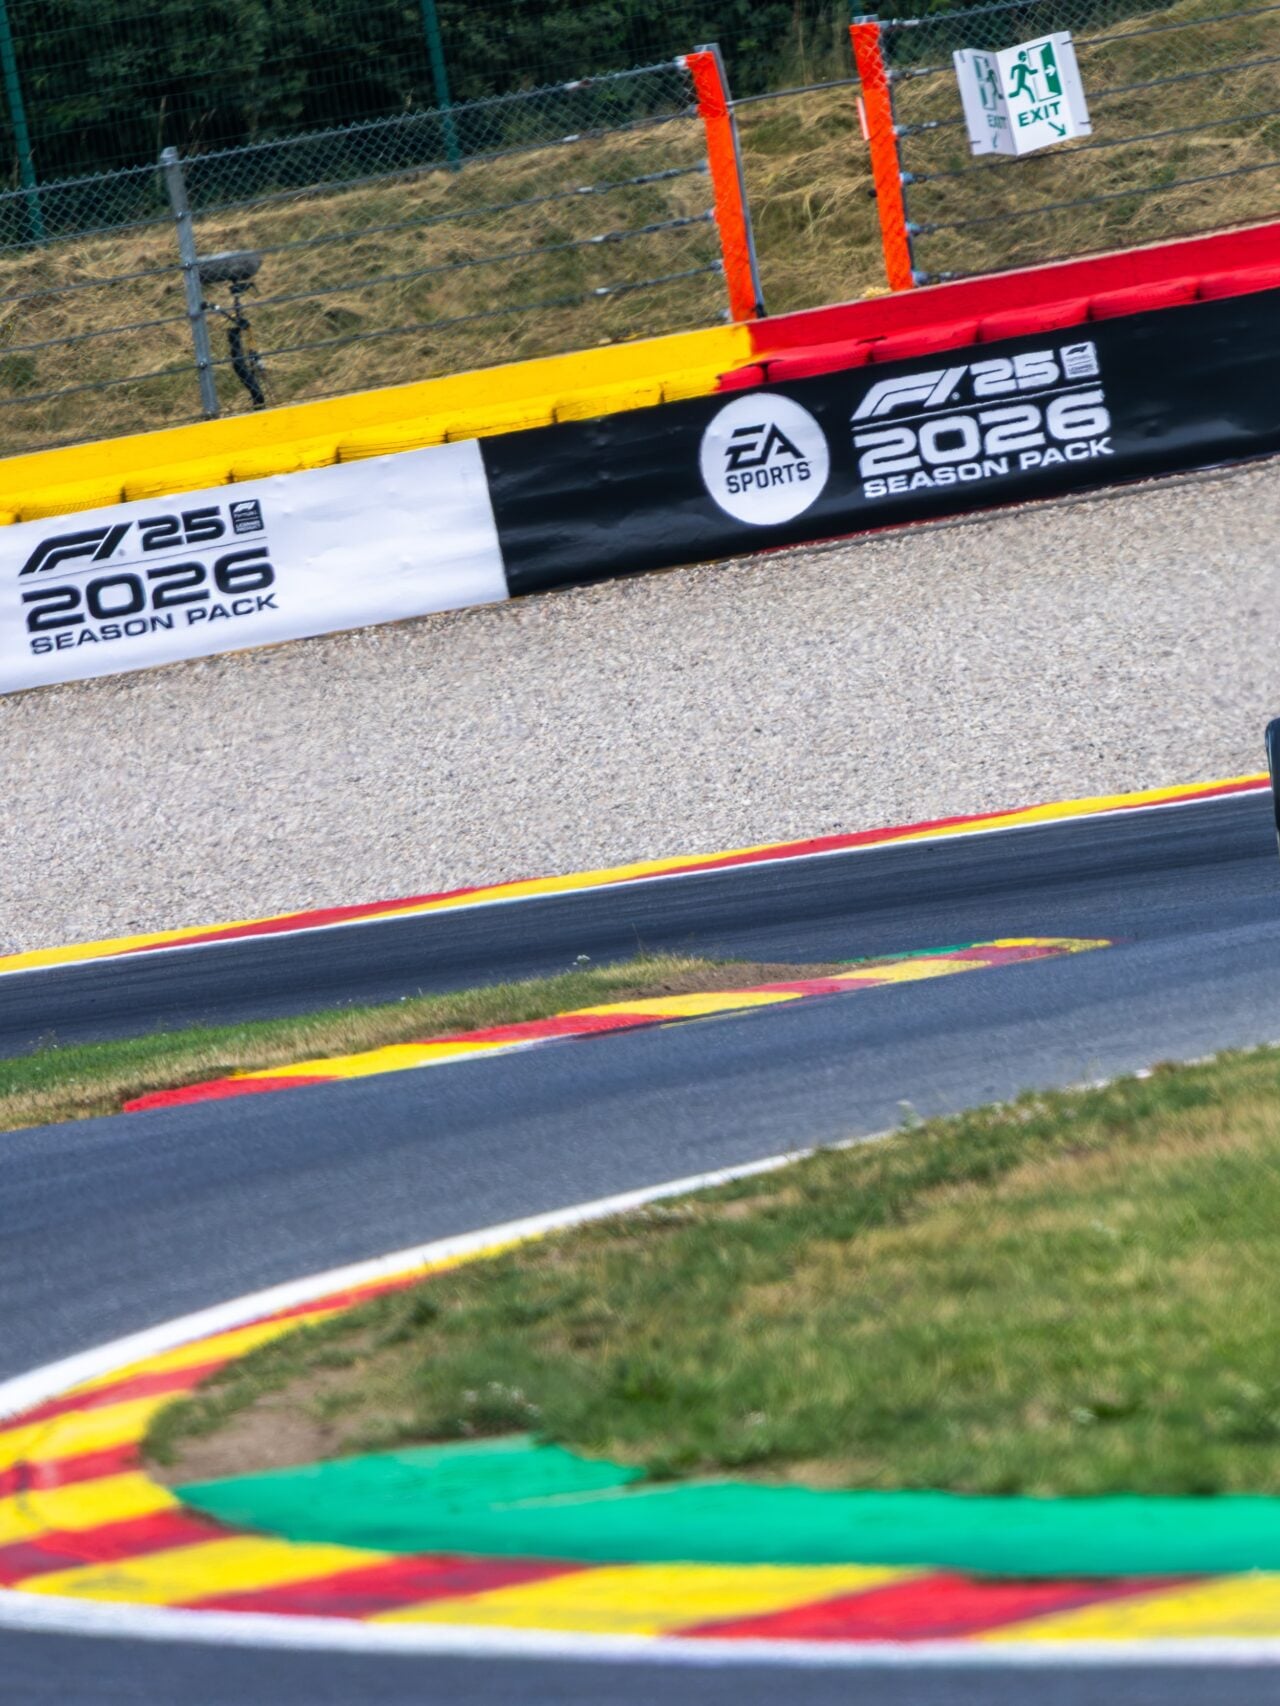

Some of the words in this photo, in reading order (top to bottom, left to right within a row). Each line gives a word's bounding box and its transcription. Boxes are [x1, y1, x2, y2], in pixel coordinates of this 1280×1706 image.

[1018, 101, 1061, 127] EXIT
[970, 350, 1060, 397] 25
[725, 422, 805, 472] EA
[853, 389, 1111, 478] 2026
[725, 461, 811, 495] SPORTS
[864, 460, 1009, 499] SEASON
[1020, 437, 1115, 471] PACK
[139, 506, 227, 551] 25
[22, 546, 276, 633] 2026
[30, 614, 173, 655] SEASON
[187, 593, 279, 626] PACK
